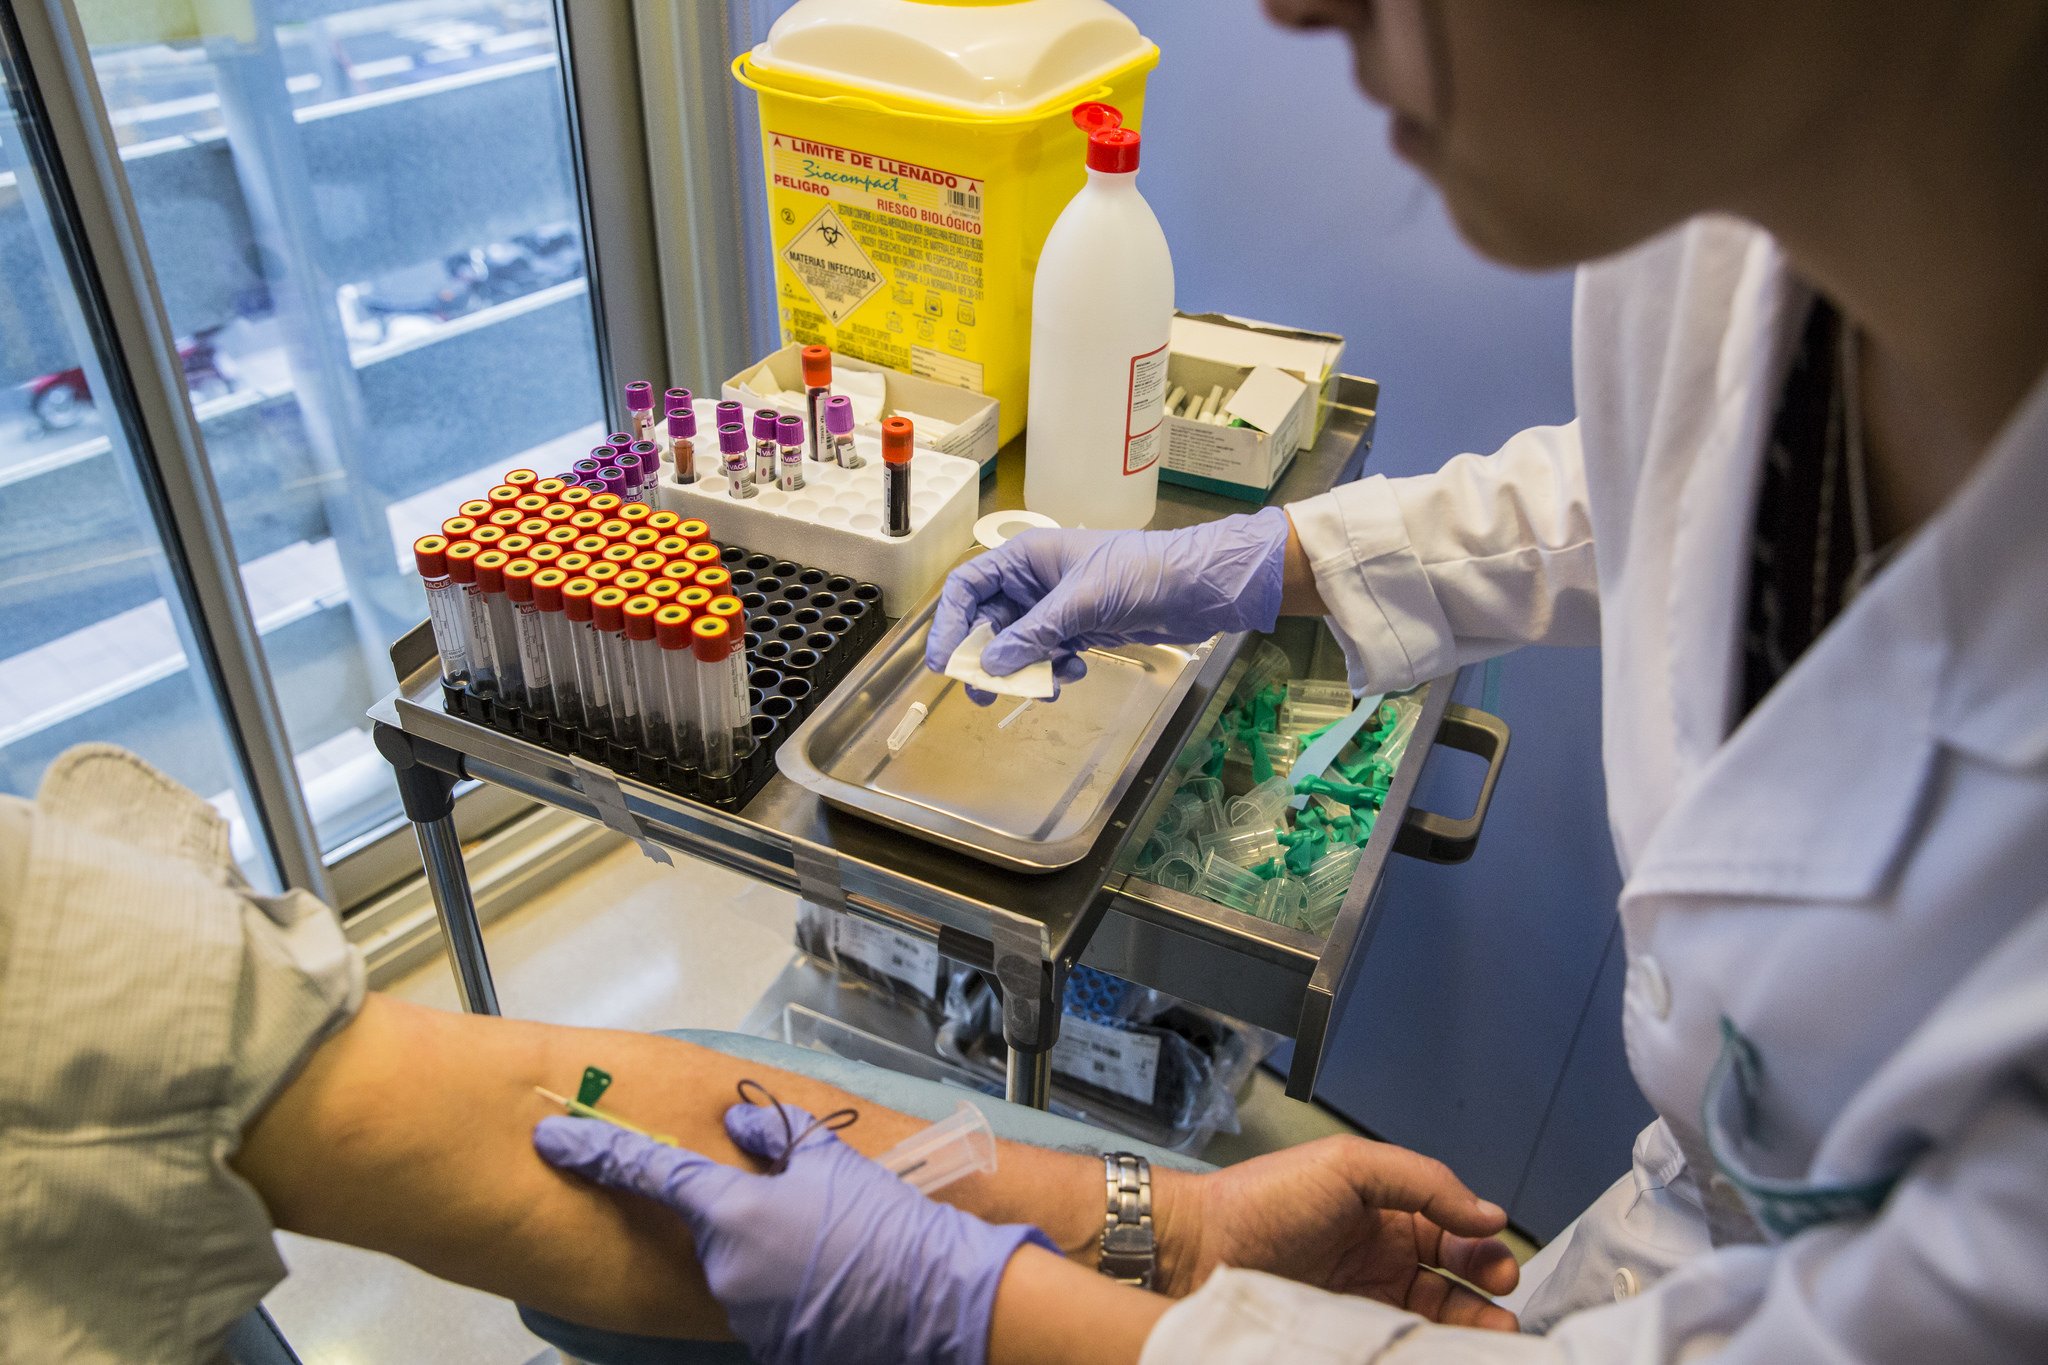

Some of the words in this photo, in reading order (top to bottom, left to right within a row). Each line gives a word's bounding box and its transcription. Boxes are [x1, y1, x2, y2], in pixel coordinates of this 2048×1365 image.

[792, 140, 844, 162] LIMITE
[851, 153, 873, 169] DE
[879, 160, 957, 189] LLENADO
[774, 174, 830, 196] PELIGRO
[877, 199, 917, 219] RIESGO
[921, 210, 981, 235] BIOLÓGICO
[789, 252, 825, 269] MATERIAS
[828, 261, 876, 282] INFECCIOSAS
[833, 310, 838, 319] 6
